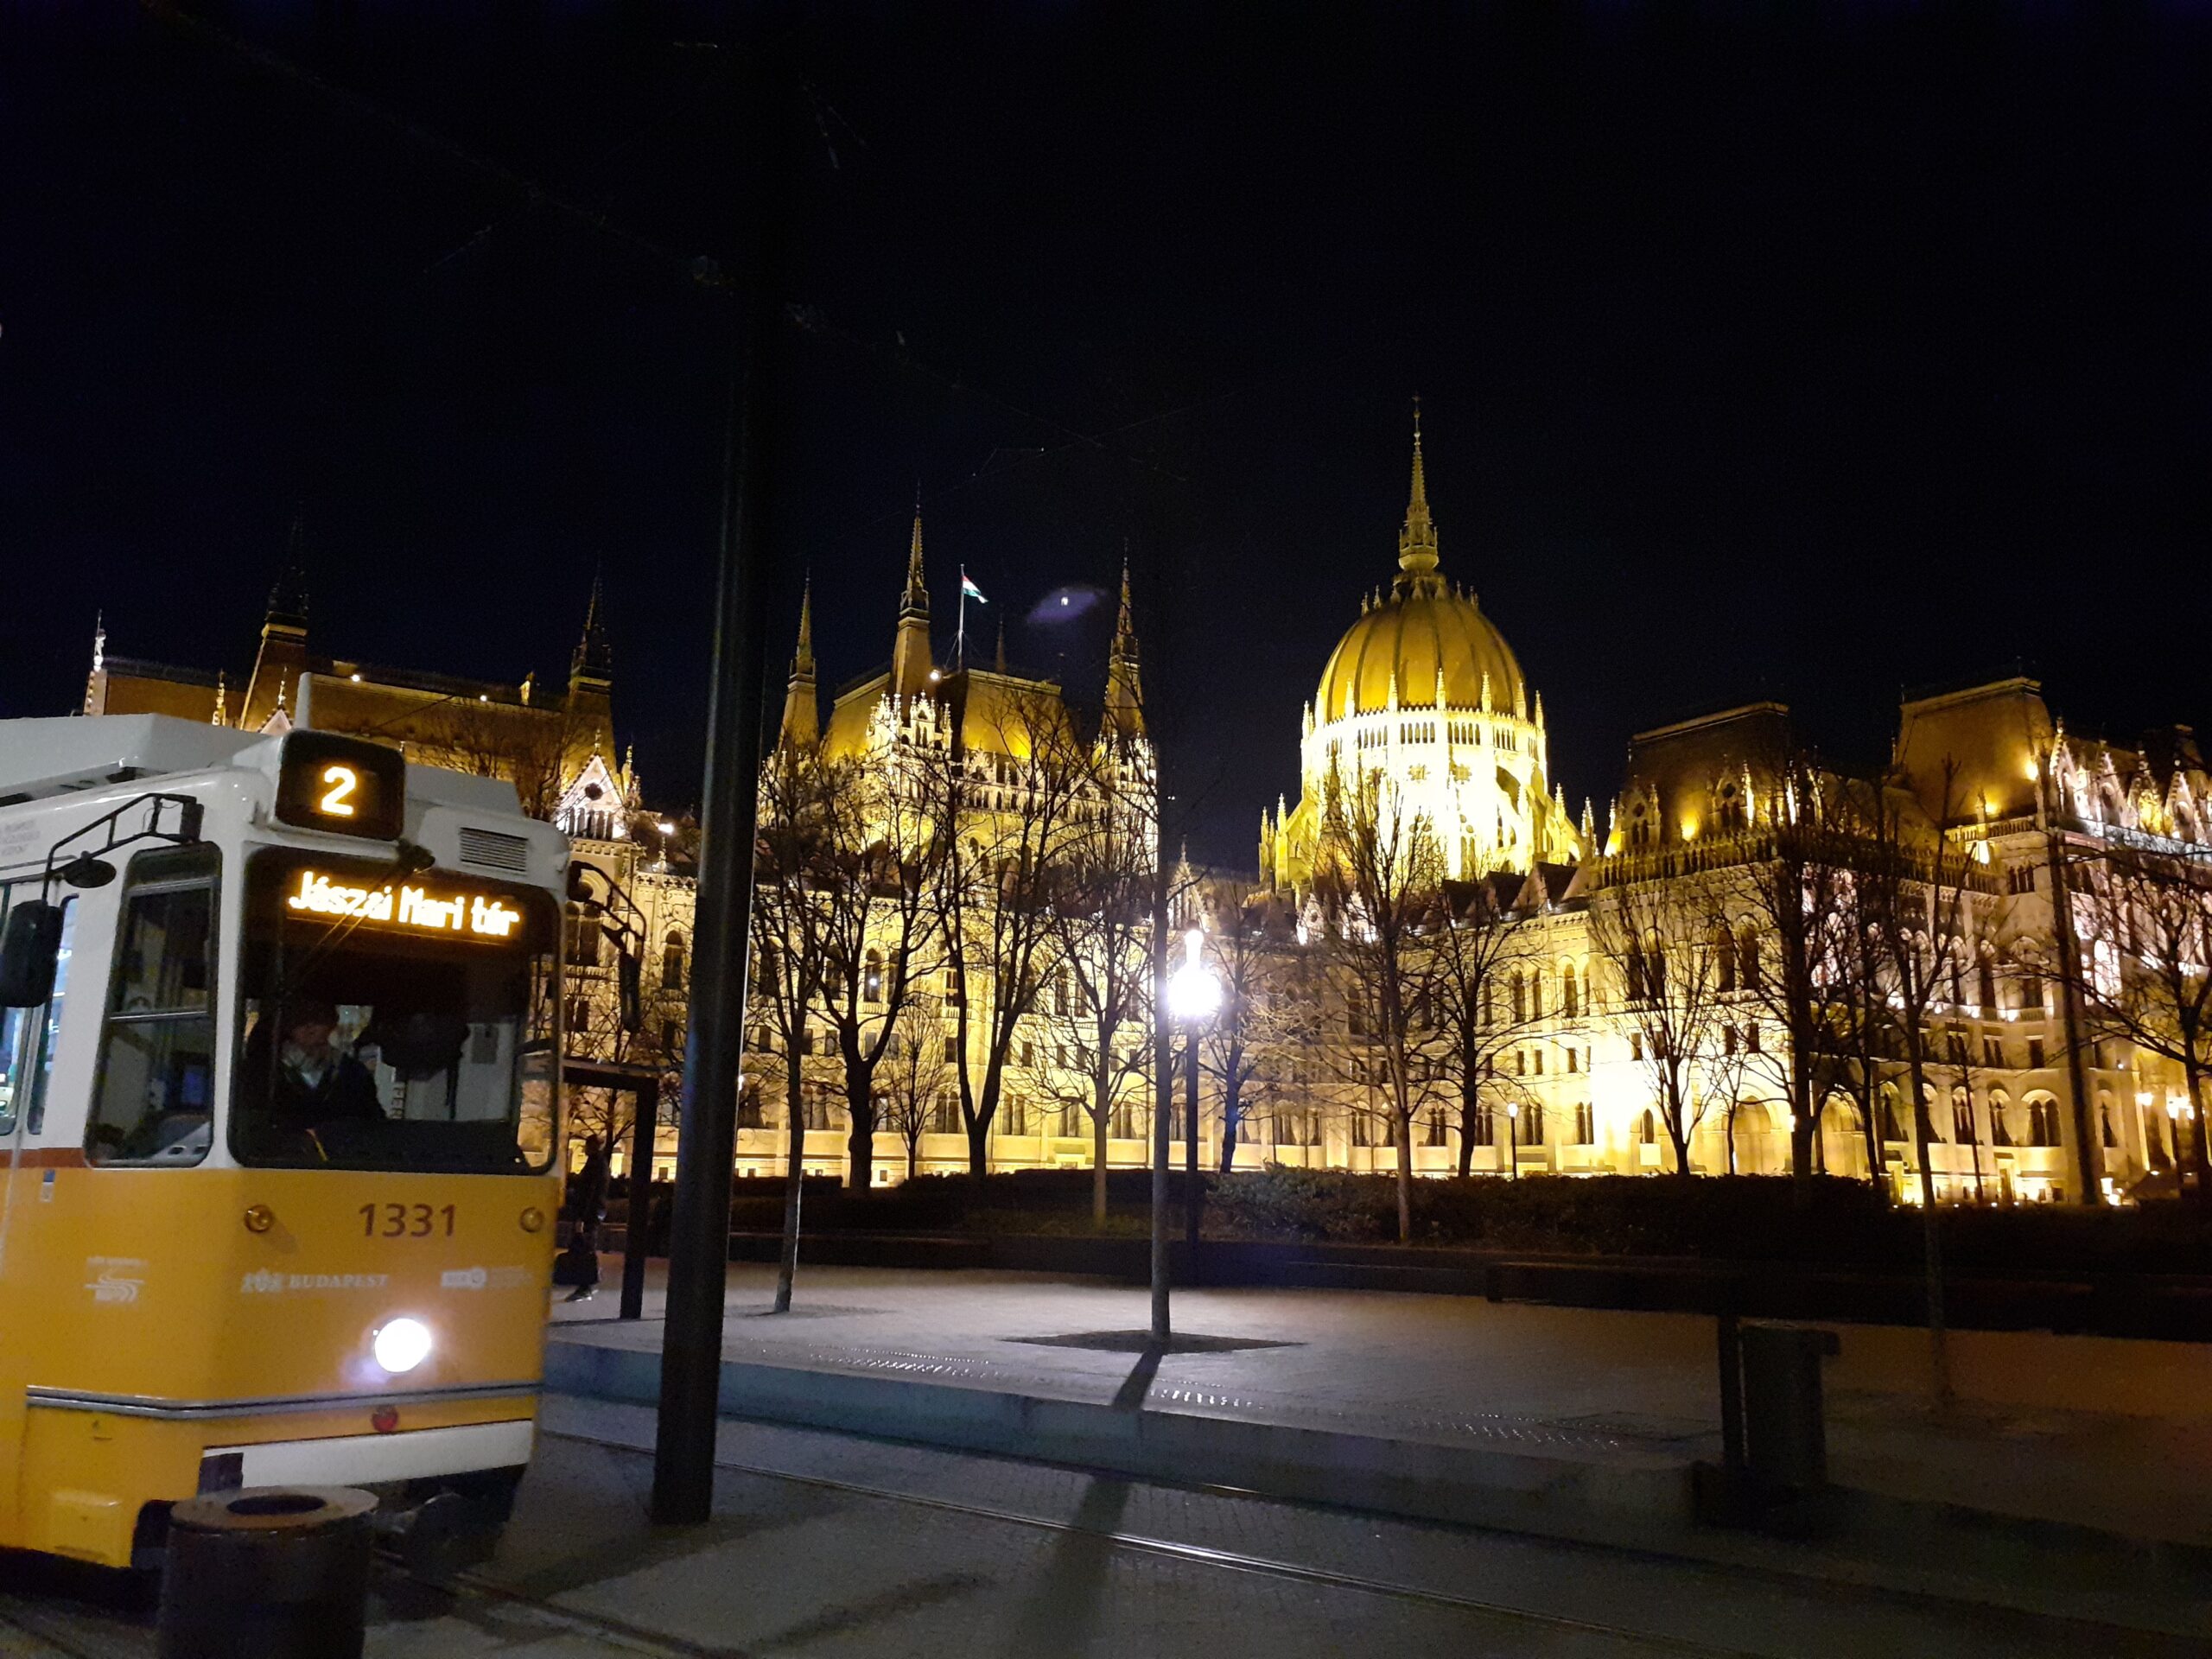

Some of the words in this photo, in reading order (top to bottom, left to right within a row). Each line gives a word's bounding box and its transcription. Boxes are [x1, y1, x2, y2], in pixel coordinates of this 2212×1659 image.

[321, 766, 357, 816] 2
[289, 870, 393, 921] Jászai
[398, 885, 465, 930] Mari
[471, 895, 519, 936] tér
[359, 1202, 456, 1238] 1331
[288, 1272, 390, 1290] BUDAPEST
